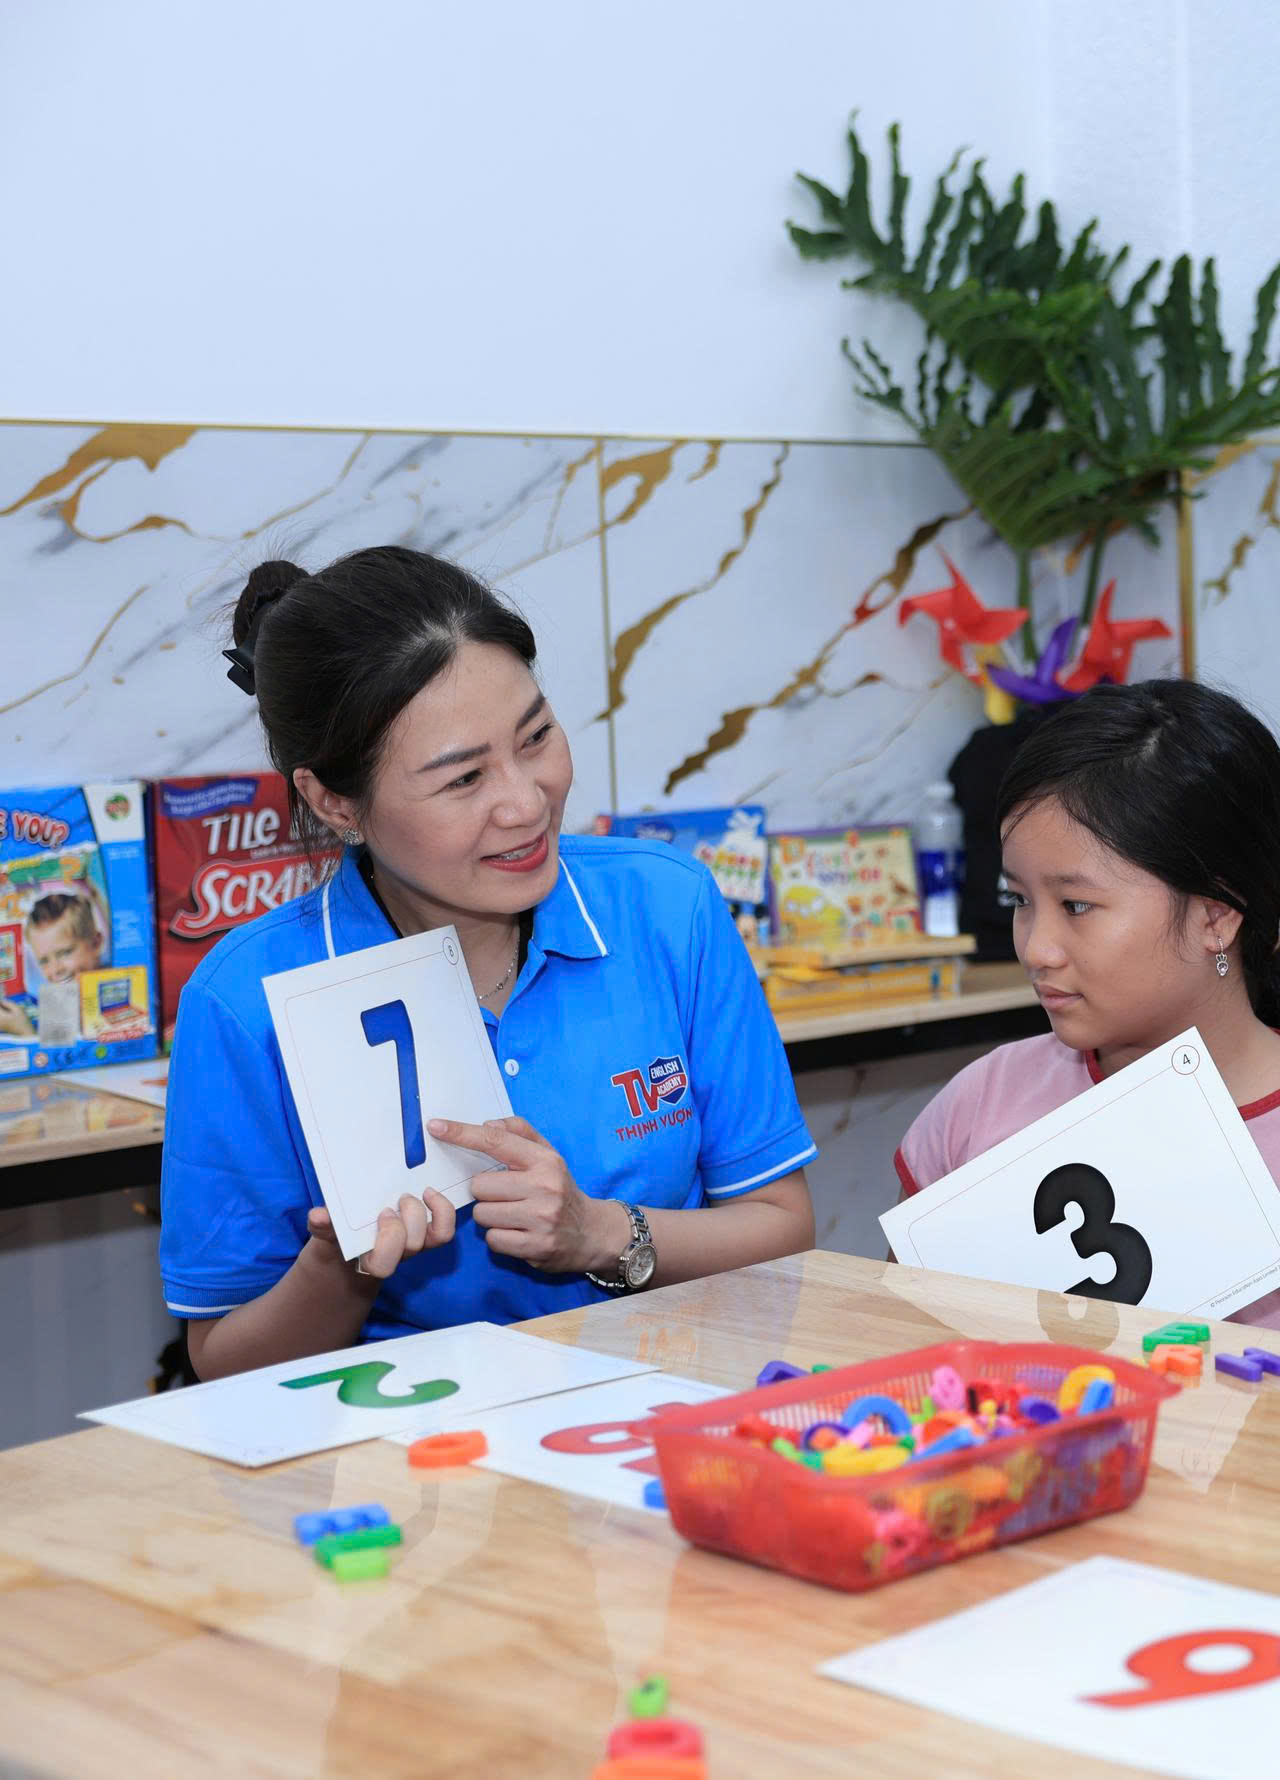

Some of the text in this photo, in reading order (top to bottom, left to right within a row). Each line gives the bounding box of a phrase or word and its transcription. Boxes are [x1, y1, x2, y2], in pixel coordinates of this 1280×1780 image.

[650, 1060, 680, 1080] ENGLISH
[1183, 1053, 1192, 1065] 4
[360, 998, 427, 1170] 7
[611, 1068, 660, 1118] TV
[656, 1075, 682, 1095] ACADEMY
[615, 1119, 659, 1142] THỊNH
[1033, 1162, 1153, 1306] 3
[278, 1360, 461, 1409] 2
